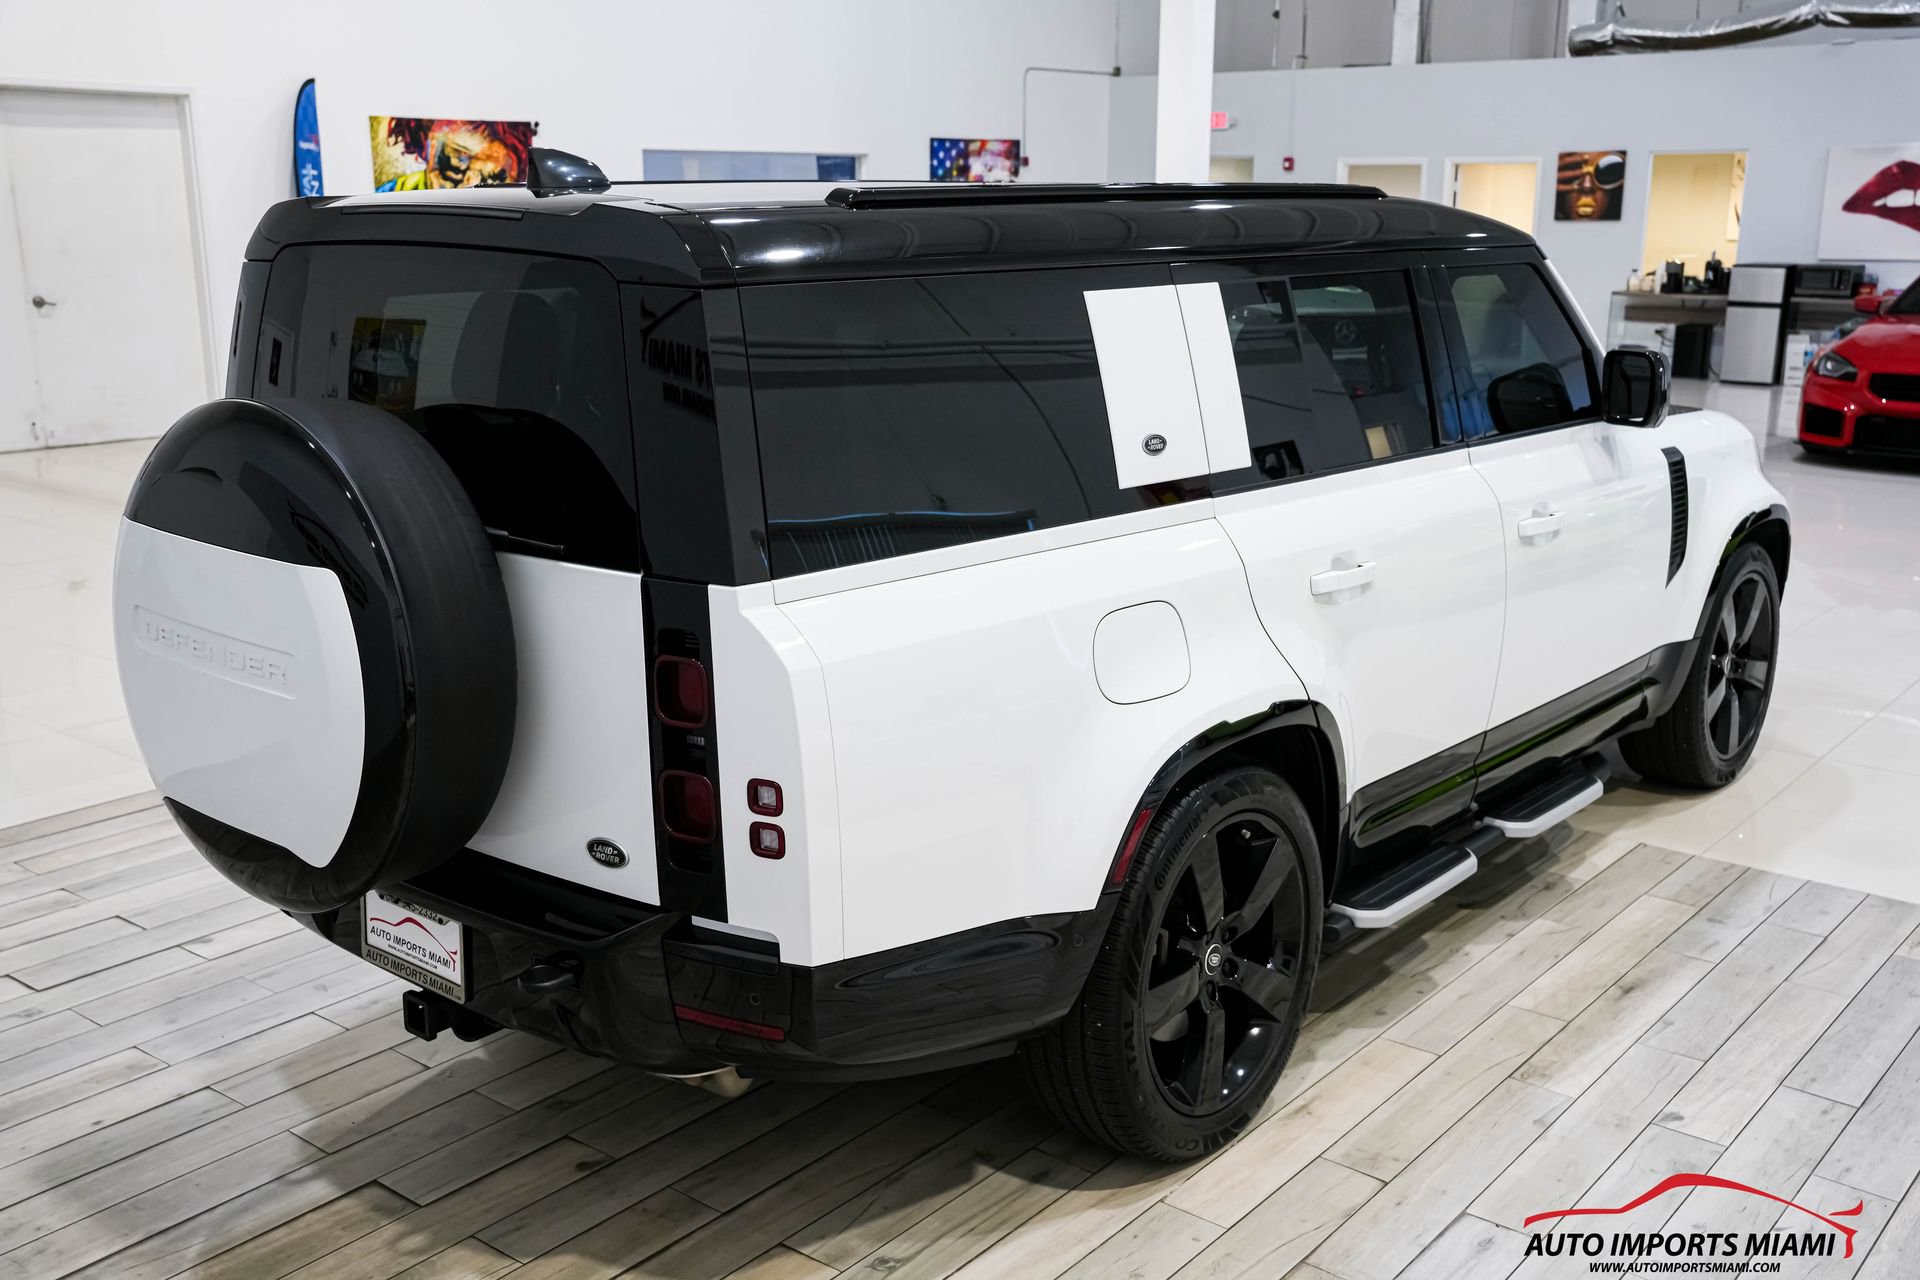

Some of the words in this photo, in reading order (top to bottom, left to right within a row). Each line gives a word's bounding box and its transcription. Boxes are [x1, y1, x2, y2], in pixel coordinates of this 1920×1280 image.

[143, 620, 290, 687] DEFENDER
[593, 843, 613, 855] LAND
[595, 852, 620, 863] ROVER
[1154, 811, 1202, 891] Continental
[370, 925, 391, 941] AUTO
[393, 935, 427, 957] IMPORTS
[428, 951, 451, 969] MIAMI
[366, 949, 390, 966] AUTO
[390, 960, 428, 984] IMPORTS
[429, 976, 454, 997] MIAMI
